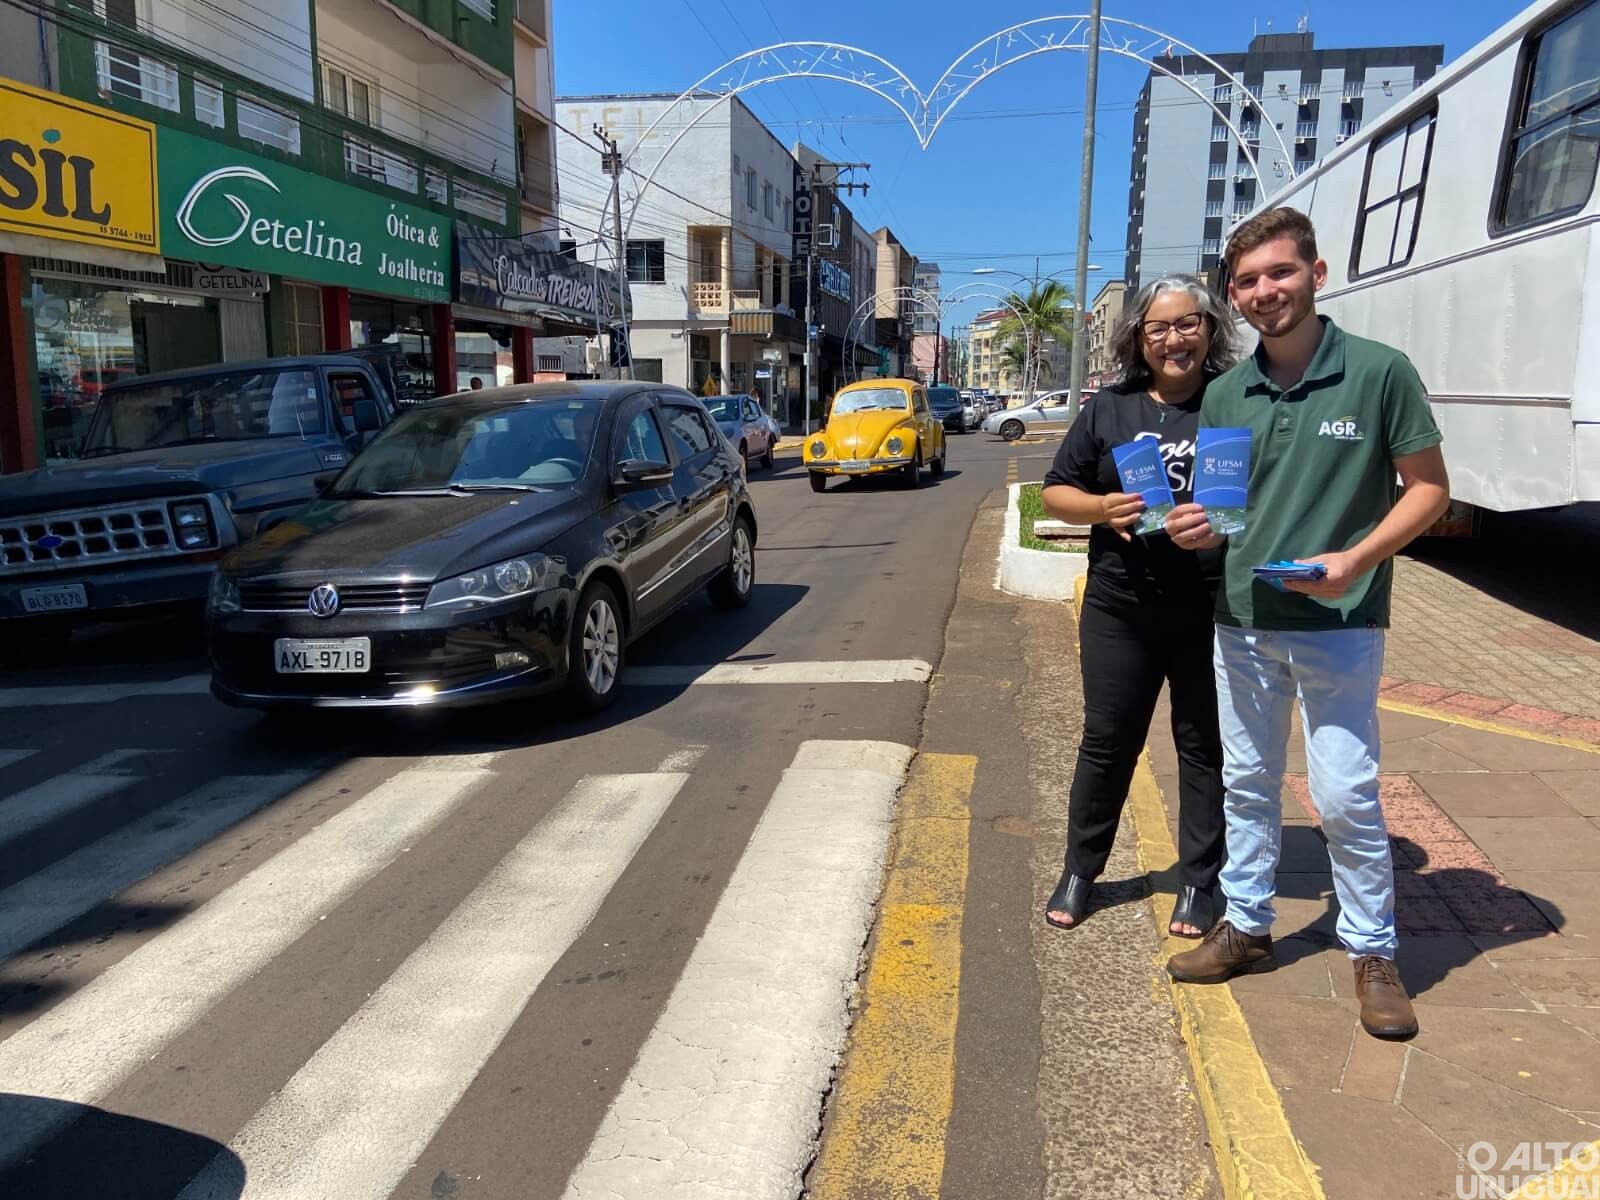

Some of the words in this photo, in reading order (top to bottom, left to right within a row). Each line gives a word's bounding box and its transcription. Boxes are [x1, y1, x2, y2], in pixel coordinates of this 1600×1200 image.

[386, 203, 425, 245] Ótica
[428, 226, 439, 249] &
[199, 275, 264, 289] GETELINA
[378, 252, 444, 287] Joalheria
[547, 274, 598, 312] TREVISO
[1217, 459, 1242, 469] UFSM
